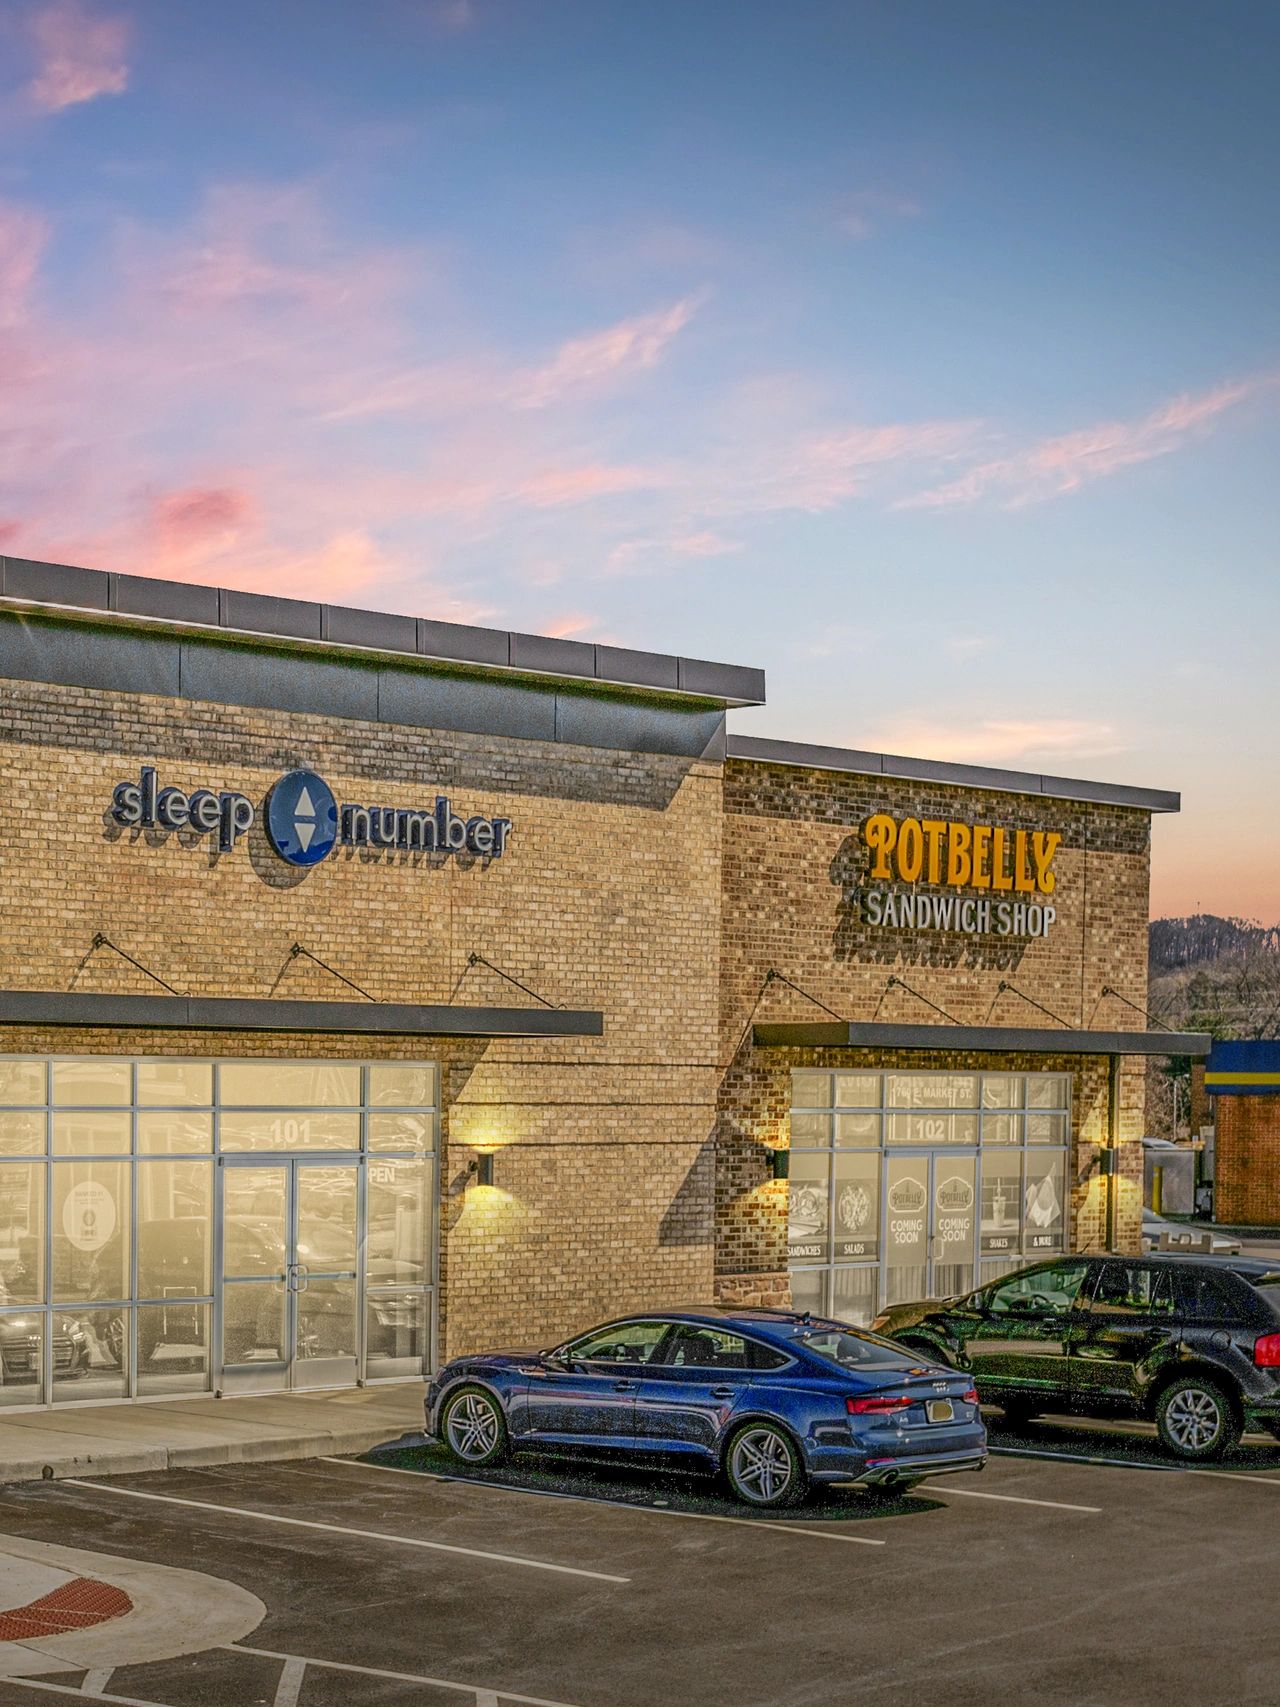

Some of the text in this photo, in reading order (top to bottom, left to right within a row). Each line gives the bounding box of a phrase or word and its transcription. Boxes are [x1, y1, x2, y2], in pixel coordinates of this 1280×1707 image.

[113, 766, 513, 858] sleep number
[865, 814, 1061, 893] POTBELLY
[867, 892, 1056, 938] SANDWICH SHOP
[923, 1087, 958, 1099] MARKET
[270, 1120, 311, 1143] 101
[916, 1119, 945, 1139] 102
[367, 1167, 396, 1183] PEN
[890, 1219, 923, 1232] COMING
[938, 1217, 970, 1231] COMING
[895, 1231, 919, 1244] SOON
[942, 1230, 966, 1242] SOON
[787, 1244, 822, 1257] SANDWICHES
[844, 1243, 865, 1255] SALADS
